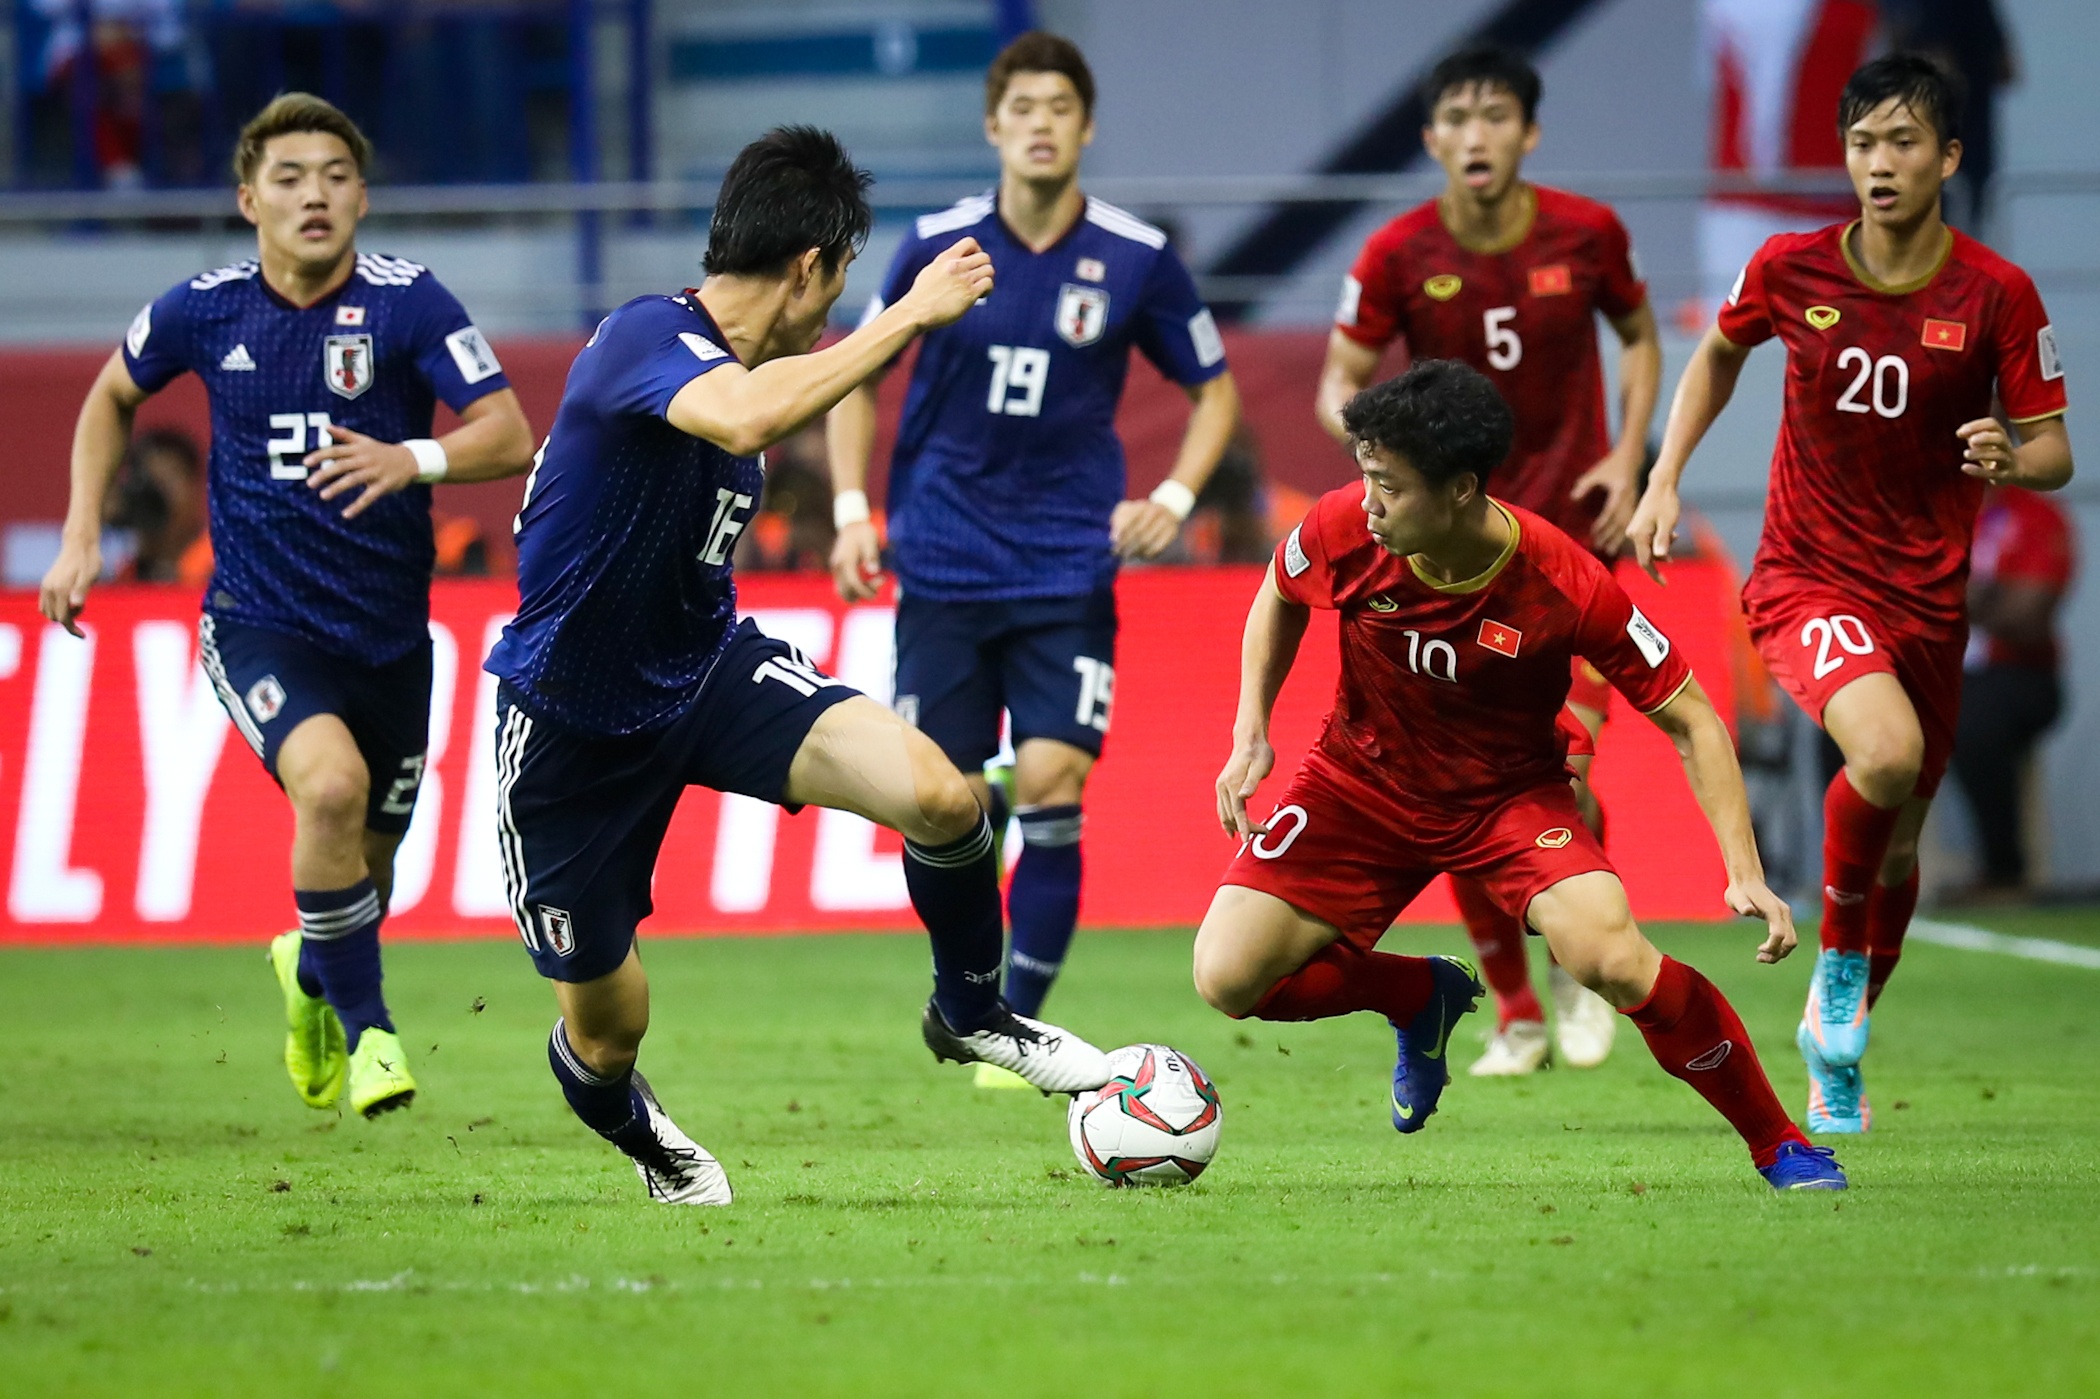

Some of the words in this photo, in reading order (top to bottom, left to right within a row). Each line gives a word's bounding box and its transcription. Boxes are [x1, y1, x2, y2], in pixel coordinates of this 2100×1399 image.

[1483, 306, 1522, 371] 5
[987, 344, 1050, 417] 19
[1836, 346, 1909, 419] 20
[267, 411, 335, 481] 21
[697, 487, 752, 566] 16
[1403, 630, 1457, 683] 10
[1801, 614, 1874, 680] 20
[0, 620, 232, 923] LY
[1236, 804, 1308, 859] 0
